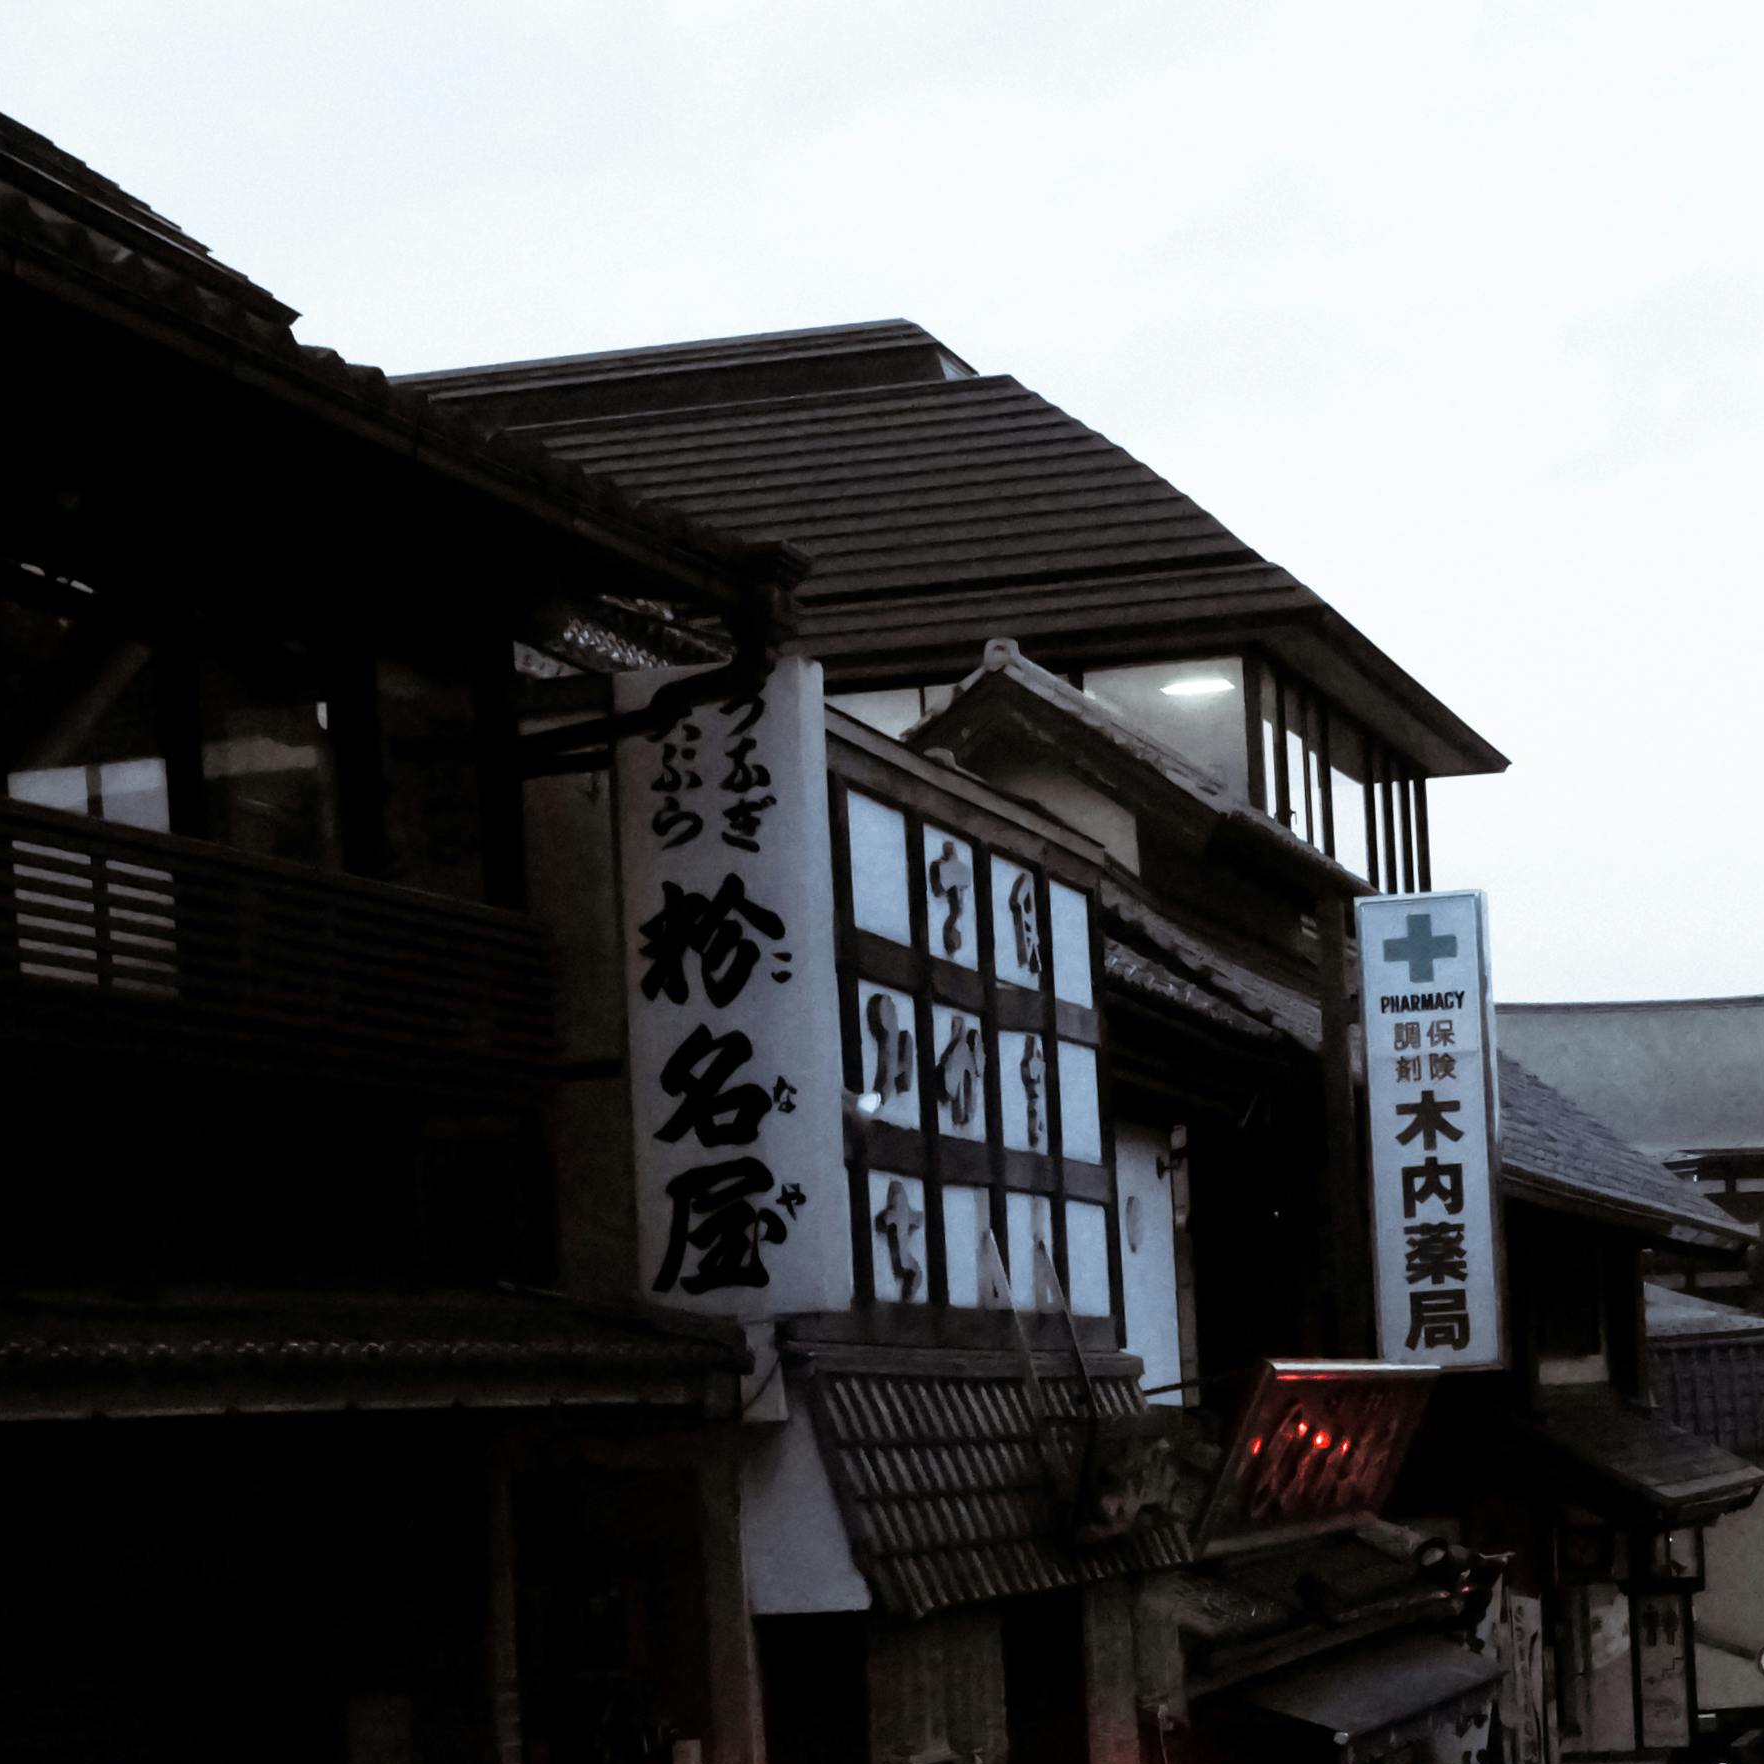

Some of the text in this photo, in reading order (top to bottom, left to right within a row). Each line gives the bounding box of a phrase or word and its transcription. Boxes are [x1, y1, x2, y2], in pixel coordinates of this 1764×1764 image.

[1380, 990, 1466, 1014] PHARMACY
[1393, 1021, 1422, 1084] 調剤
[1426, 1019, 1457, 1081] 保険
[638, 872, 788, 1295] 粉名屋
[1395, 1090, 1471, 1352] 木内薬局
